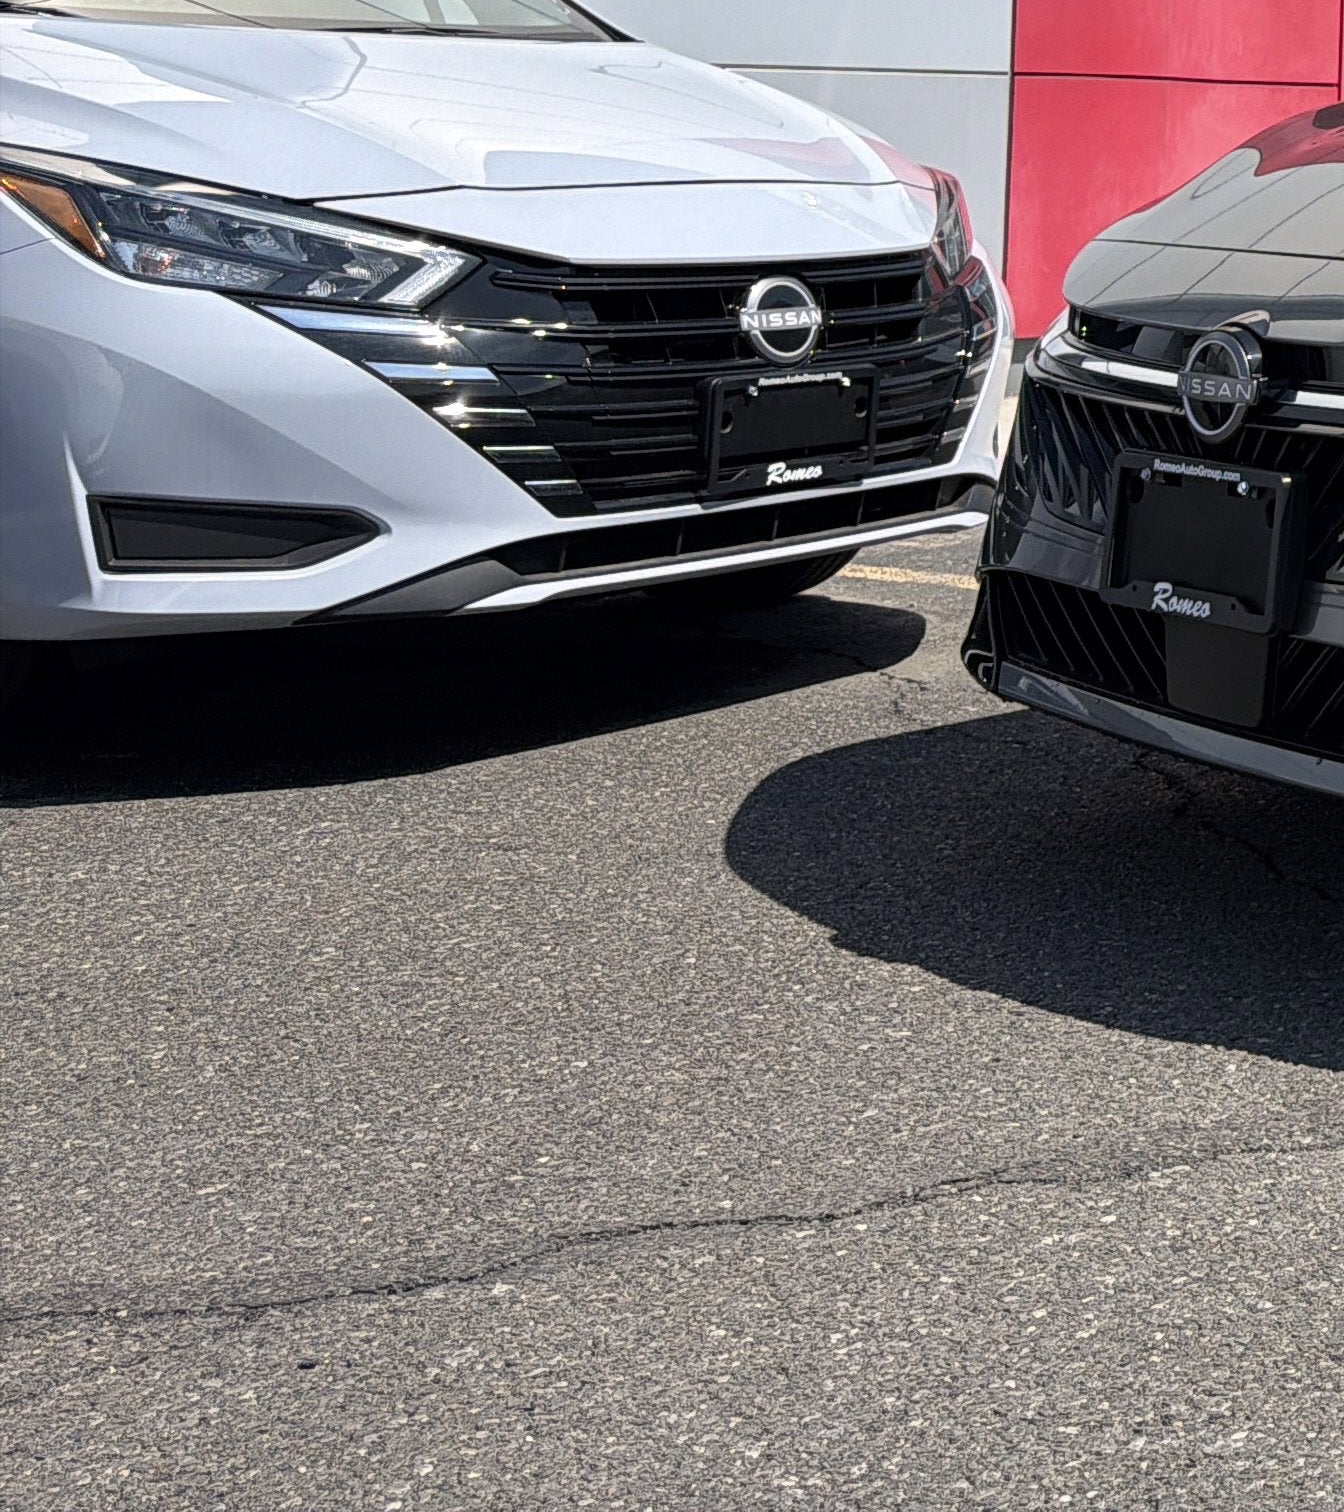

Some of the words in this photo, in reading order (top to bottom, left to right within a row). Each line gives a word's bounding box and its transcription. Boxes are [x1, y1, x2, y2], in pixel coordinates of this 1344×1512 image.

[742, 311, 822, 329] NISSAN
[1179, 373, 1251, 400] NISSAN
[766, 462, 823, 486] Romeo
[1154, 459, 1241, 482] RomeoAutoGroup.com
[1151, 581, 1211, 618] Romeo
